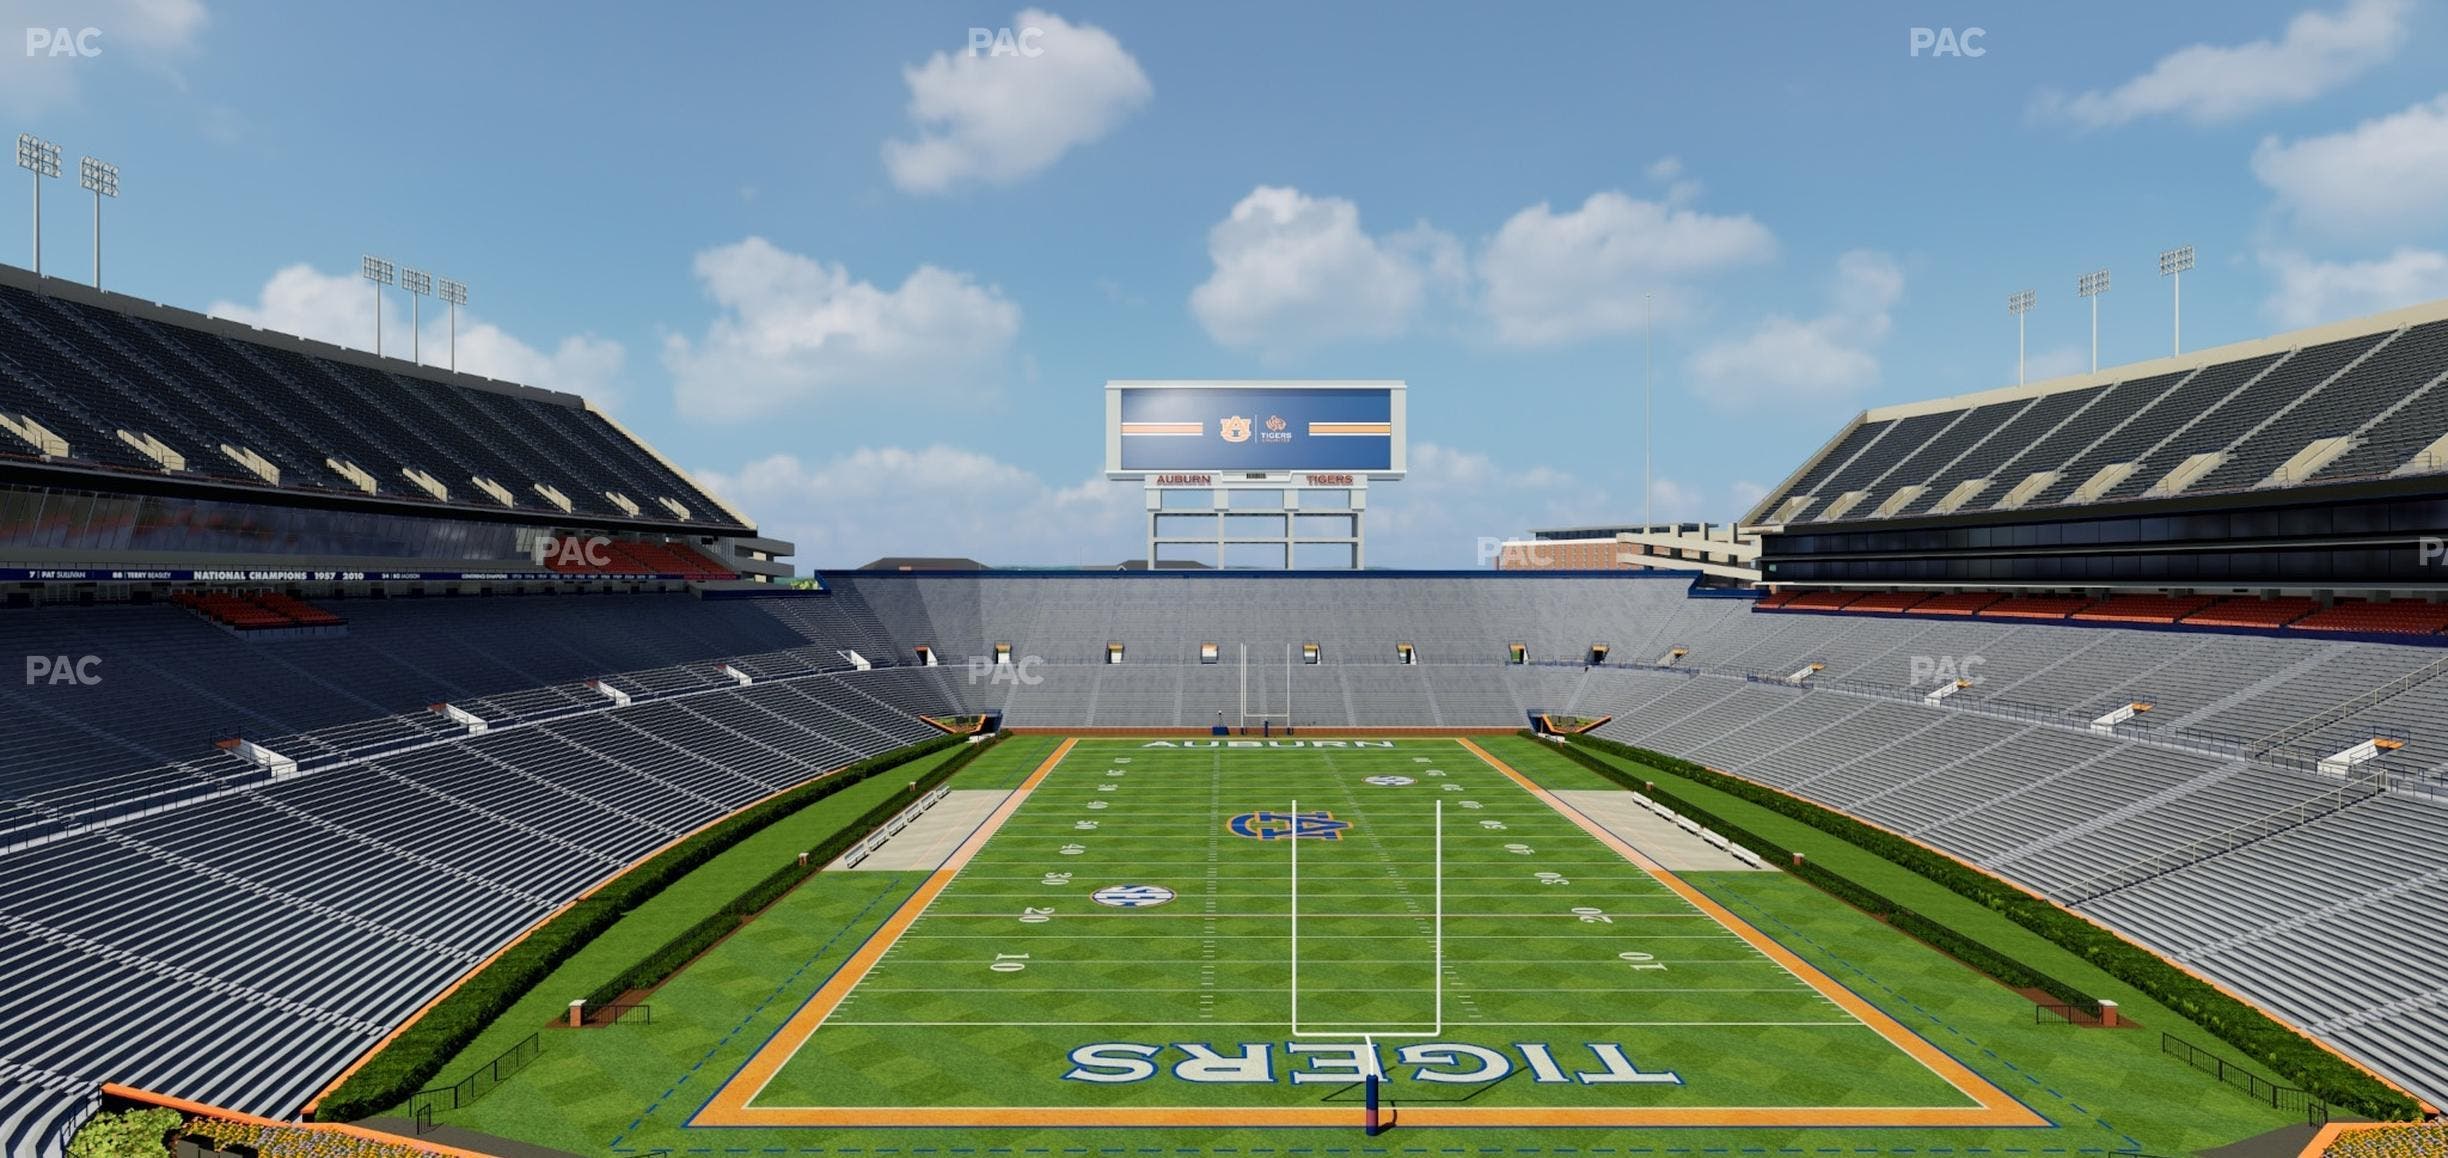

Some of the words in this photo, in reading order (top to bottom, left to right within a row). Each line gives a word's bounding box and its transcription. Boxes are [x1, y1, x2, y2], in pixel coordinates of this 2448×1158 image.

[1157, 475, 1211, 486] AUBURN
[1306, 475, 1354, 486] TIGERS
[41, 571, 55, 579] PAT
[127, 572, 146, 580] TERRY
[193, 571, 246, 580] NATIONAL
[249, 571, 307, 581] CHAMPIONS
[314, 572, 336, 581] 1957
[342, 572, 364, 581] 2010
[1141, 740, 1395, 748] AUBURN
[1059, 844, 1086, 855] 40
[1041, 872, 1072, 885] 30
[1534, 872, 1570, 885] 30
[1019, 907, 1055, 923] 20
[1571, 907, 1613, 924] 20
[990, 953, 1030, 972] 10
[1619, 952, 1668, 971] 10
[1060, 1041, 1686, 1085] TIGERS
